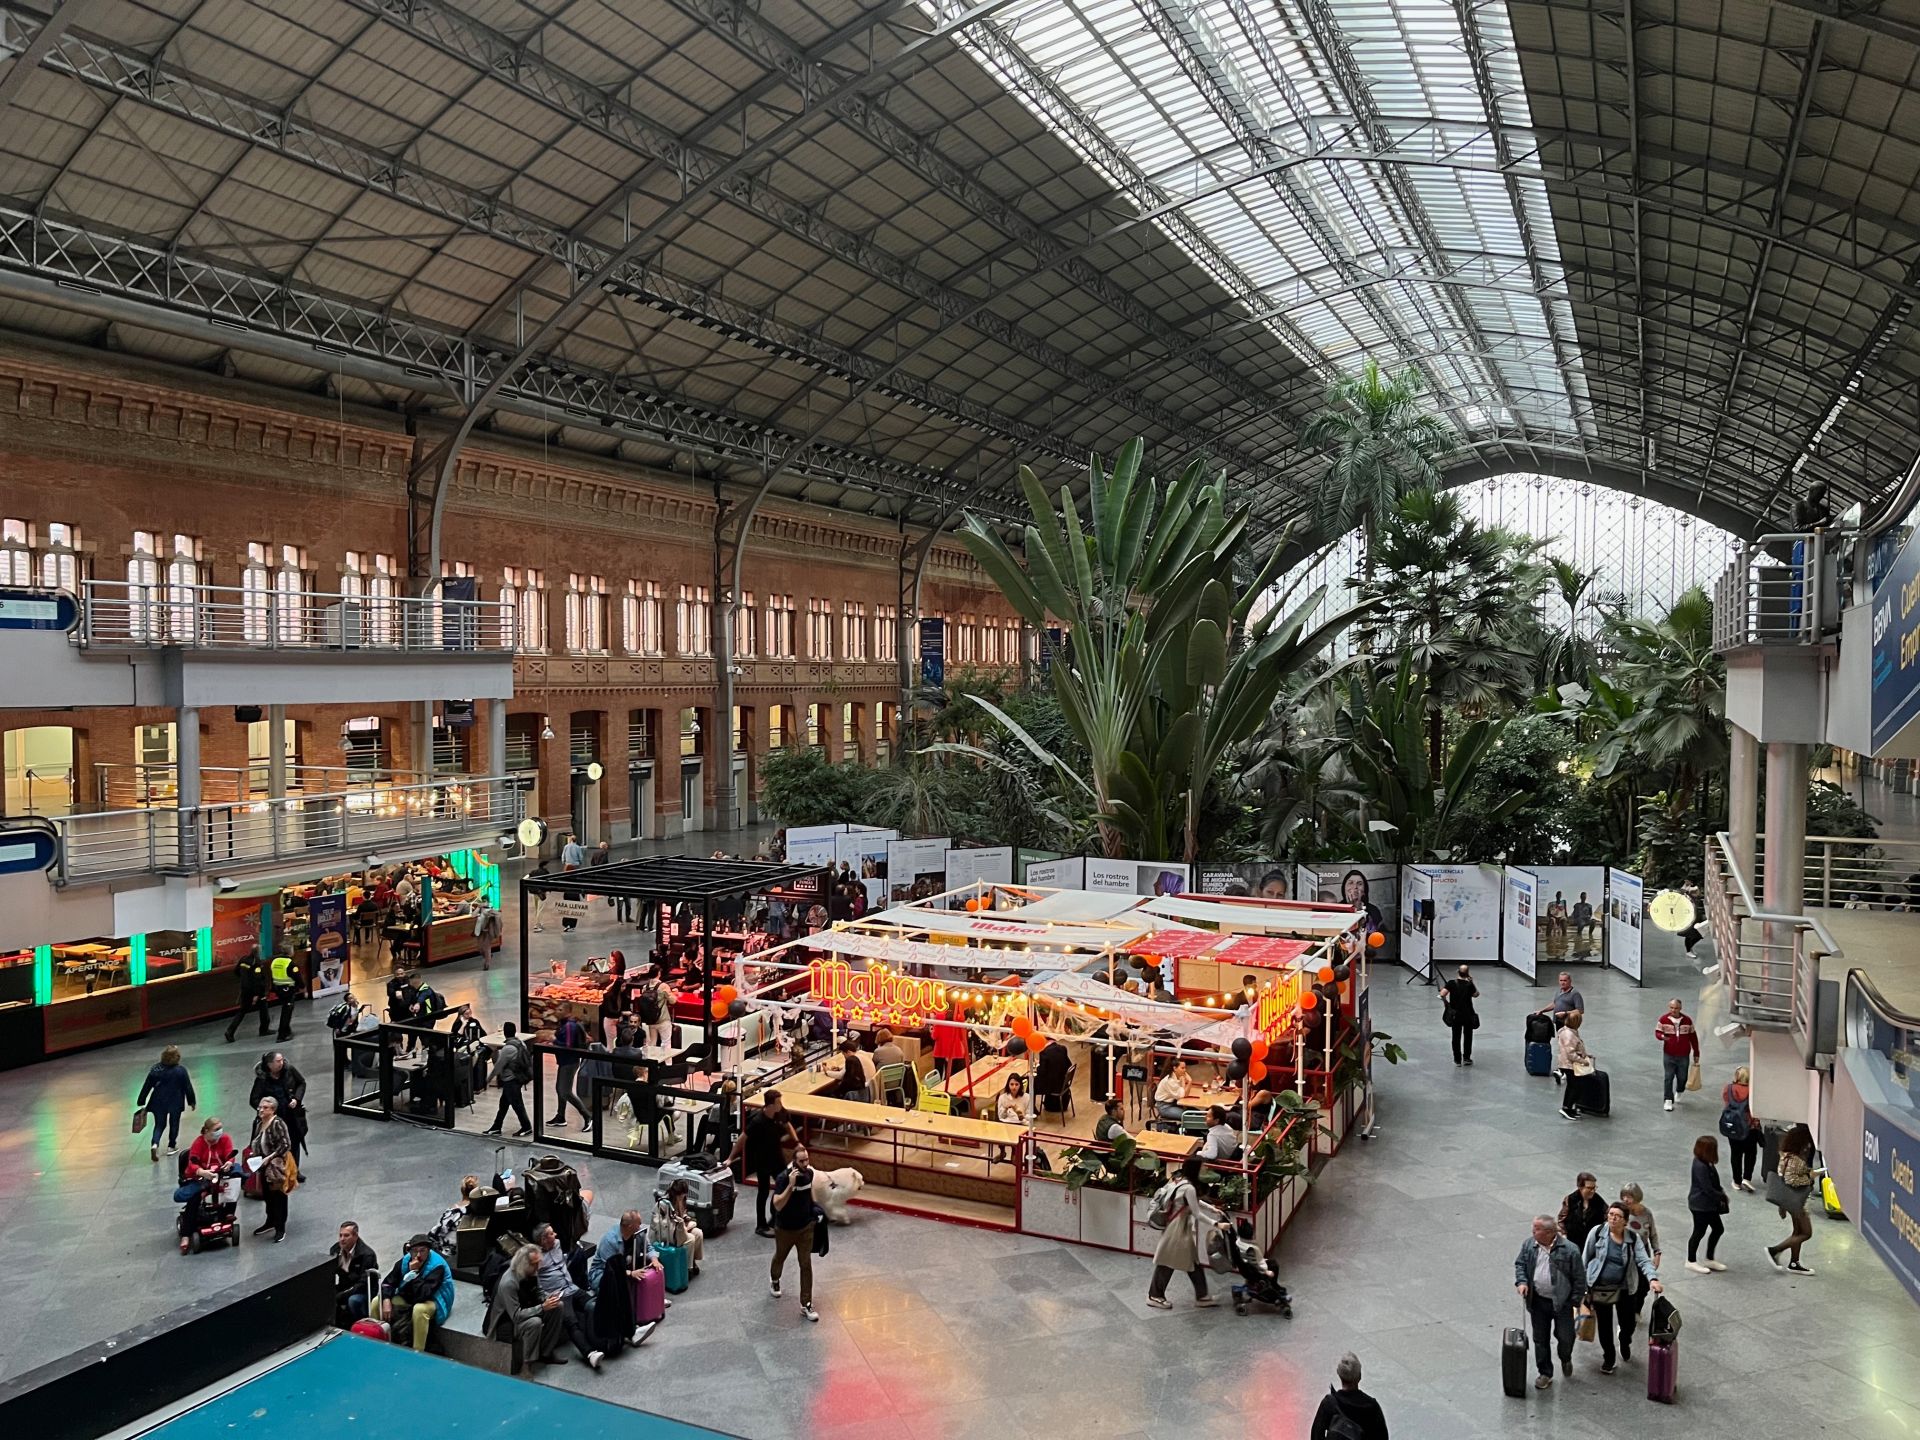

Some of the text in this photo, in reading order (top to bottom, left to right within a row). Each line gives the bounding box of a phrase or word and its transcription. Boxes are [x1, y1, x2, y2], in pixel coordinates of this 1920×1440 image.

[1873, 594, 1891, 647] BBVA
[1030, 869, 1038, 877] Los
[1038, 874, 1055, 882] hambre
[968, 921, 1050, 935] Mahou
[216, 934, 255, 946] CERVEZA
[159, 946, 187, 957] TAPAS
[65, 960, 120, 974] APERITIVOS
[808, 958, 950, 1013] Mahou
[1259, 974, 1298, 1034] Mahou
[1864, 1129, 1880, 1164] BBVA
